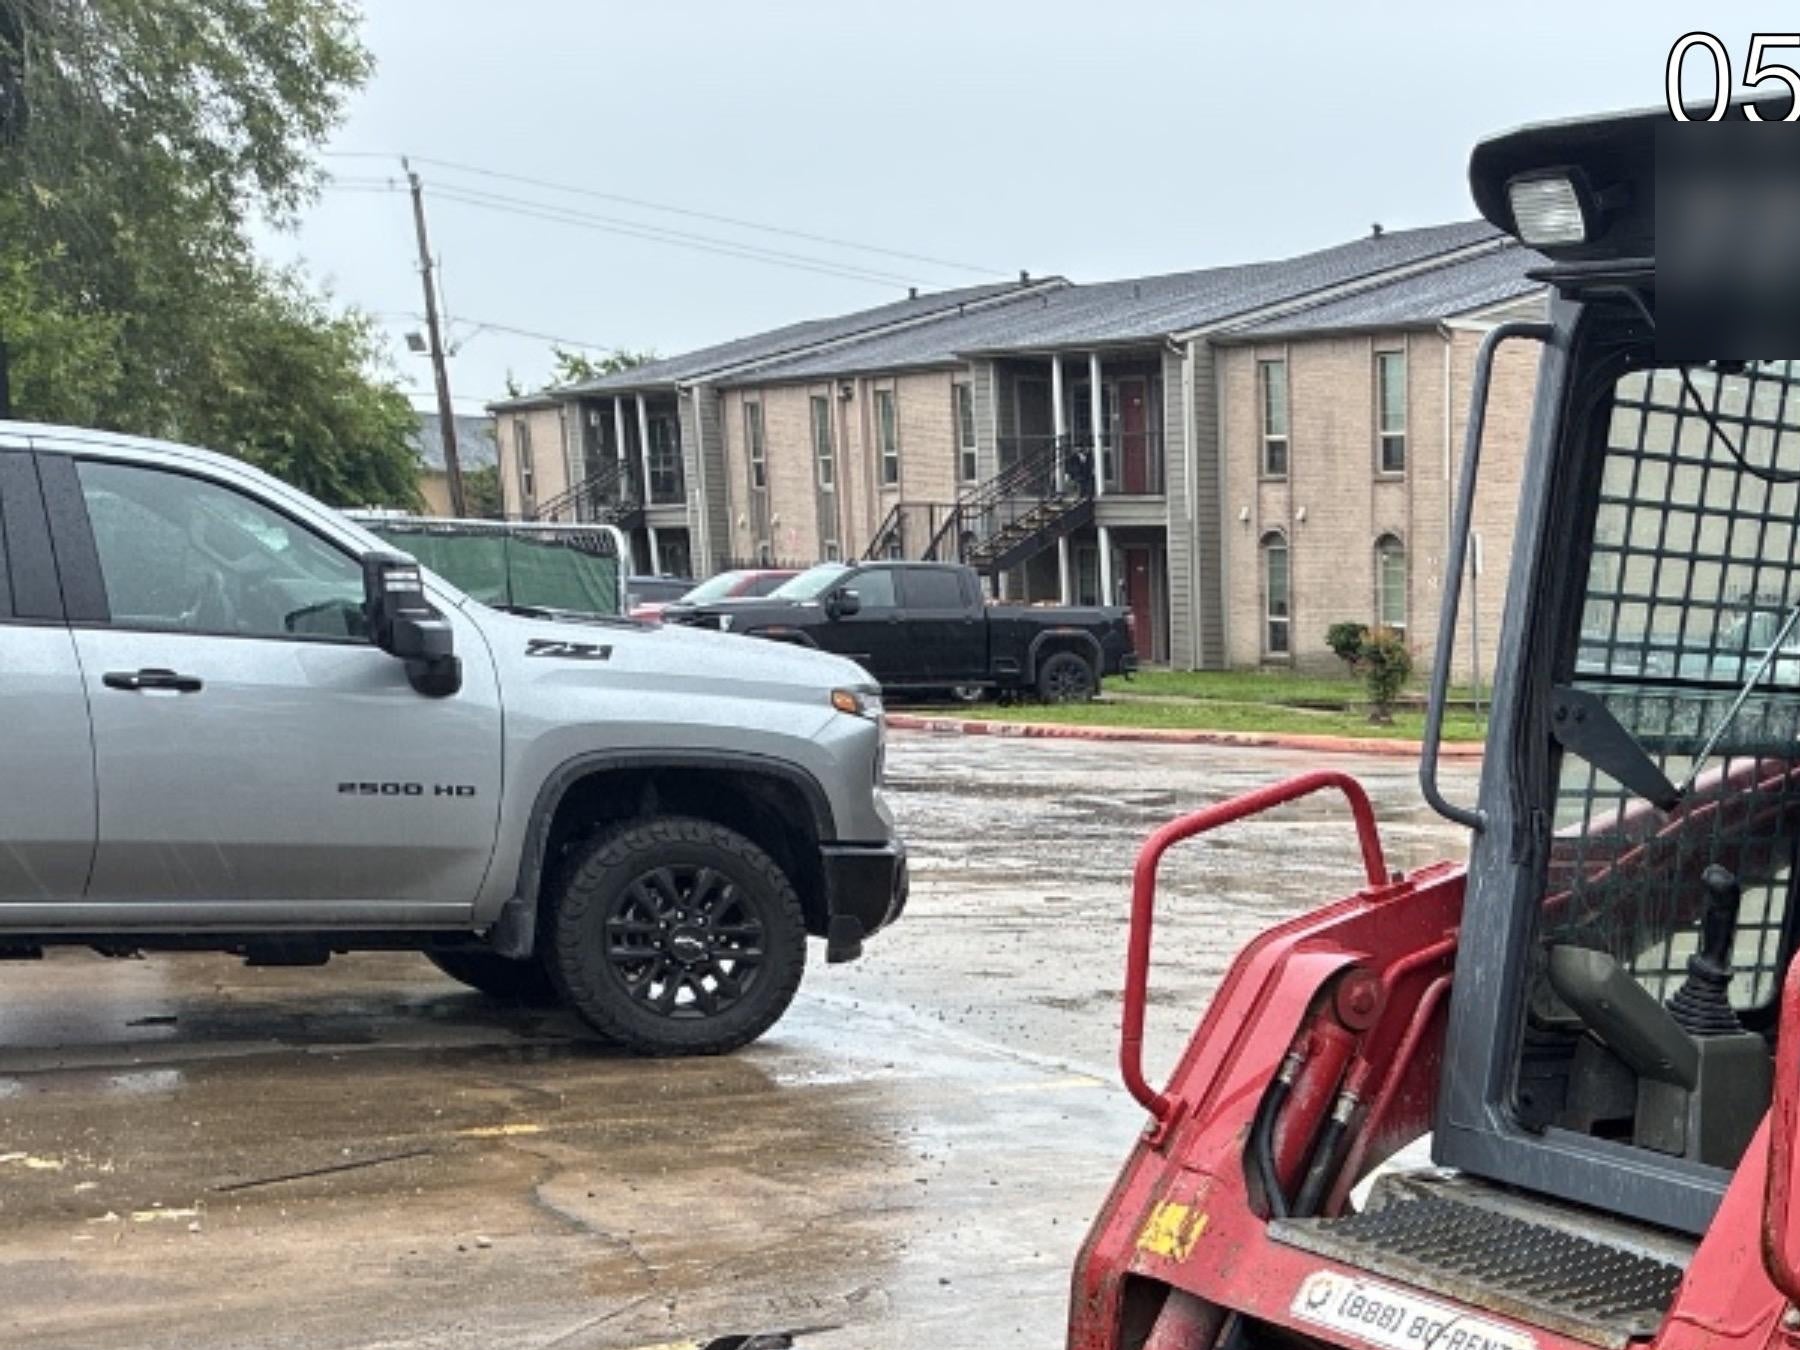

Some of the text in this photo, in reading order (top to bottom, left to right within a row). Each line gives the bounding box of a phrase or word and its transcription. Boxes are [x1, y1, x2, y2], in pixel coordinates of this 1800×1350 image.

[337, 782, 476, 797] 2500 HD
[1337, 1290, 1406, 1334] (888)
